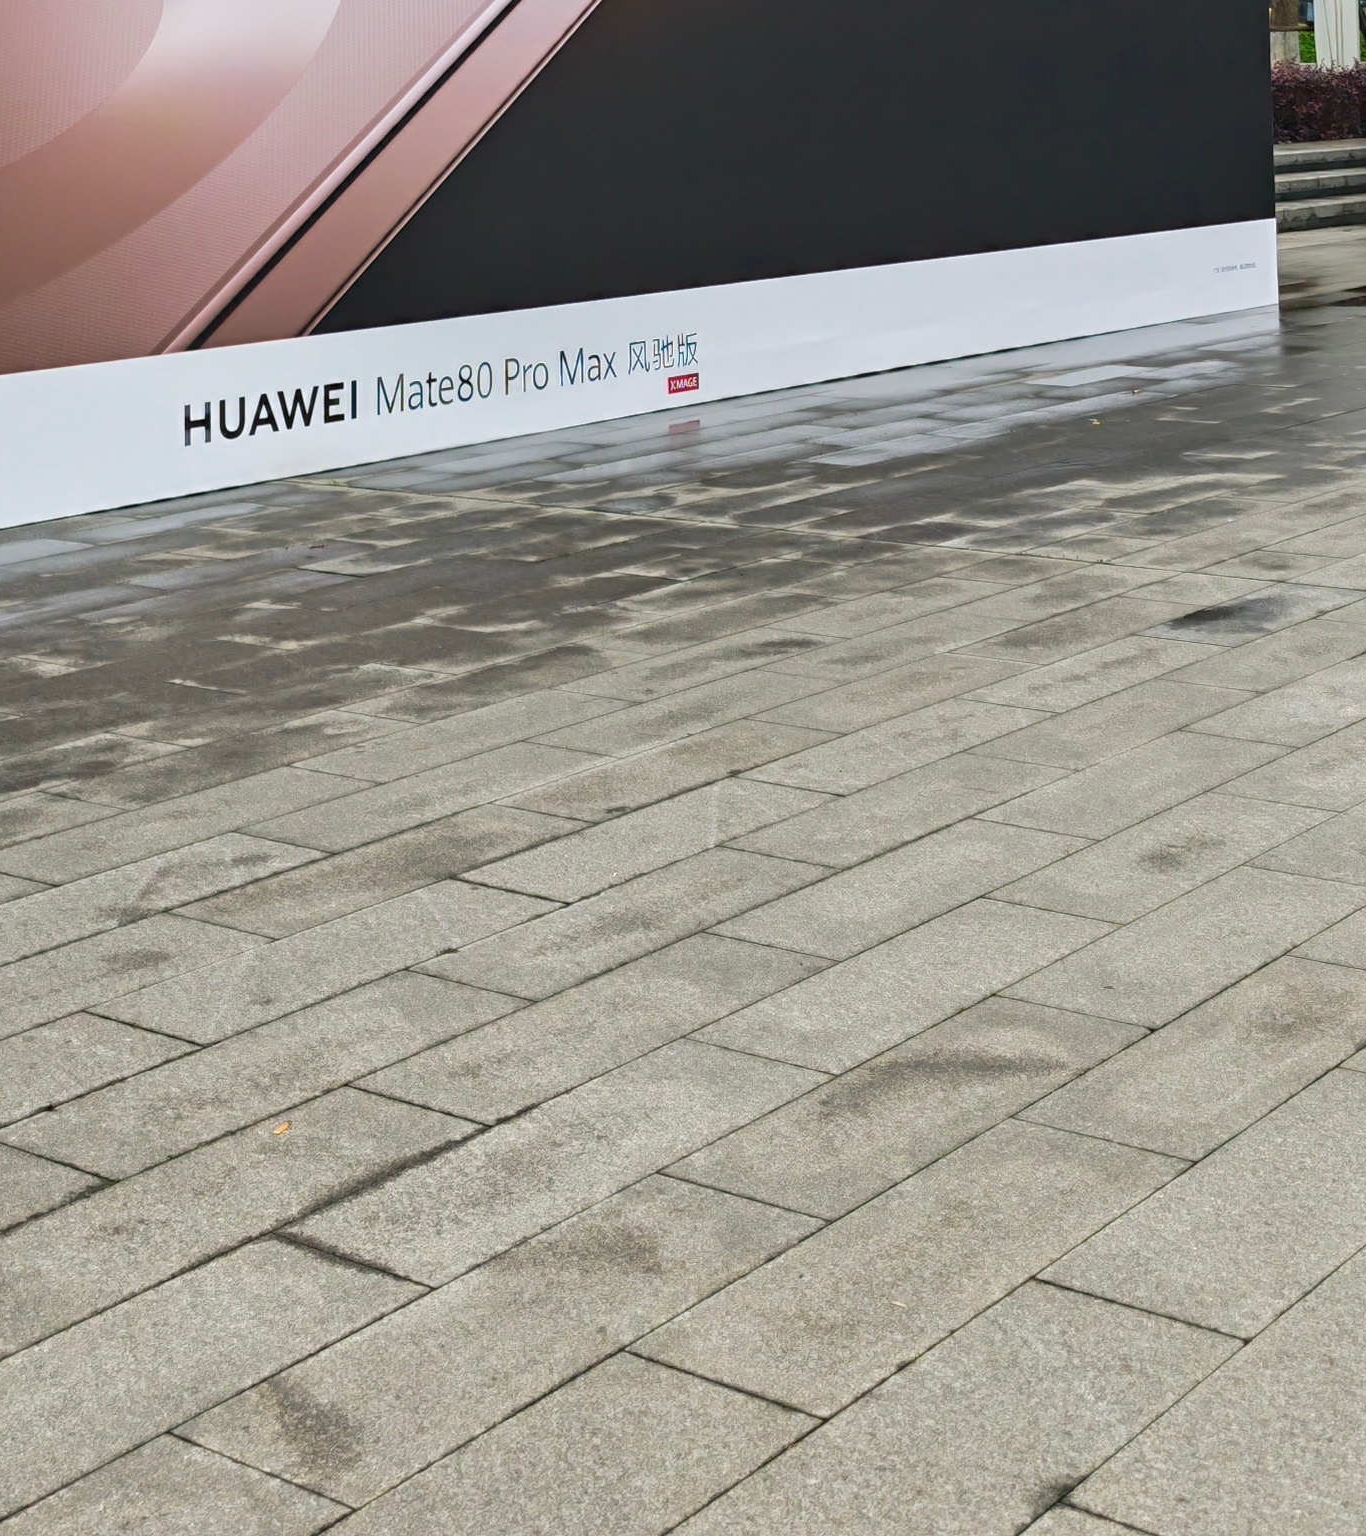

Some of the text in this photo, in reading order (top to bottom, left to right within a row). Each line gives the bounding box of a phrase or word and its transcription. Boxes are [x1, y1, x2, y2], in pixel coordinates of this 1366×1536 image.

[183, 332, 699, 447] HUAWEI Mate80 Pro Max 风驰版
[670, 376, 698, 392] XMAGE
